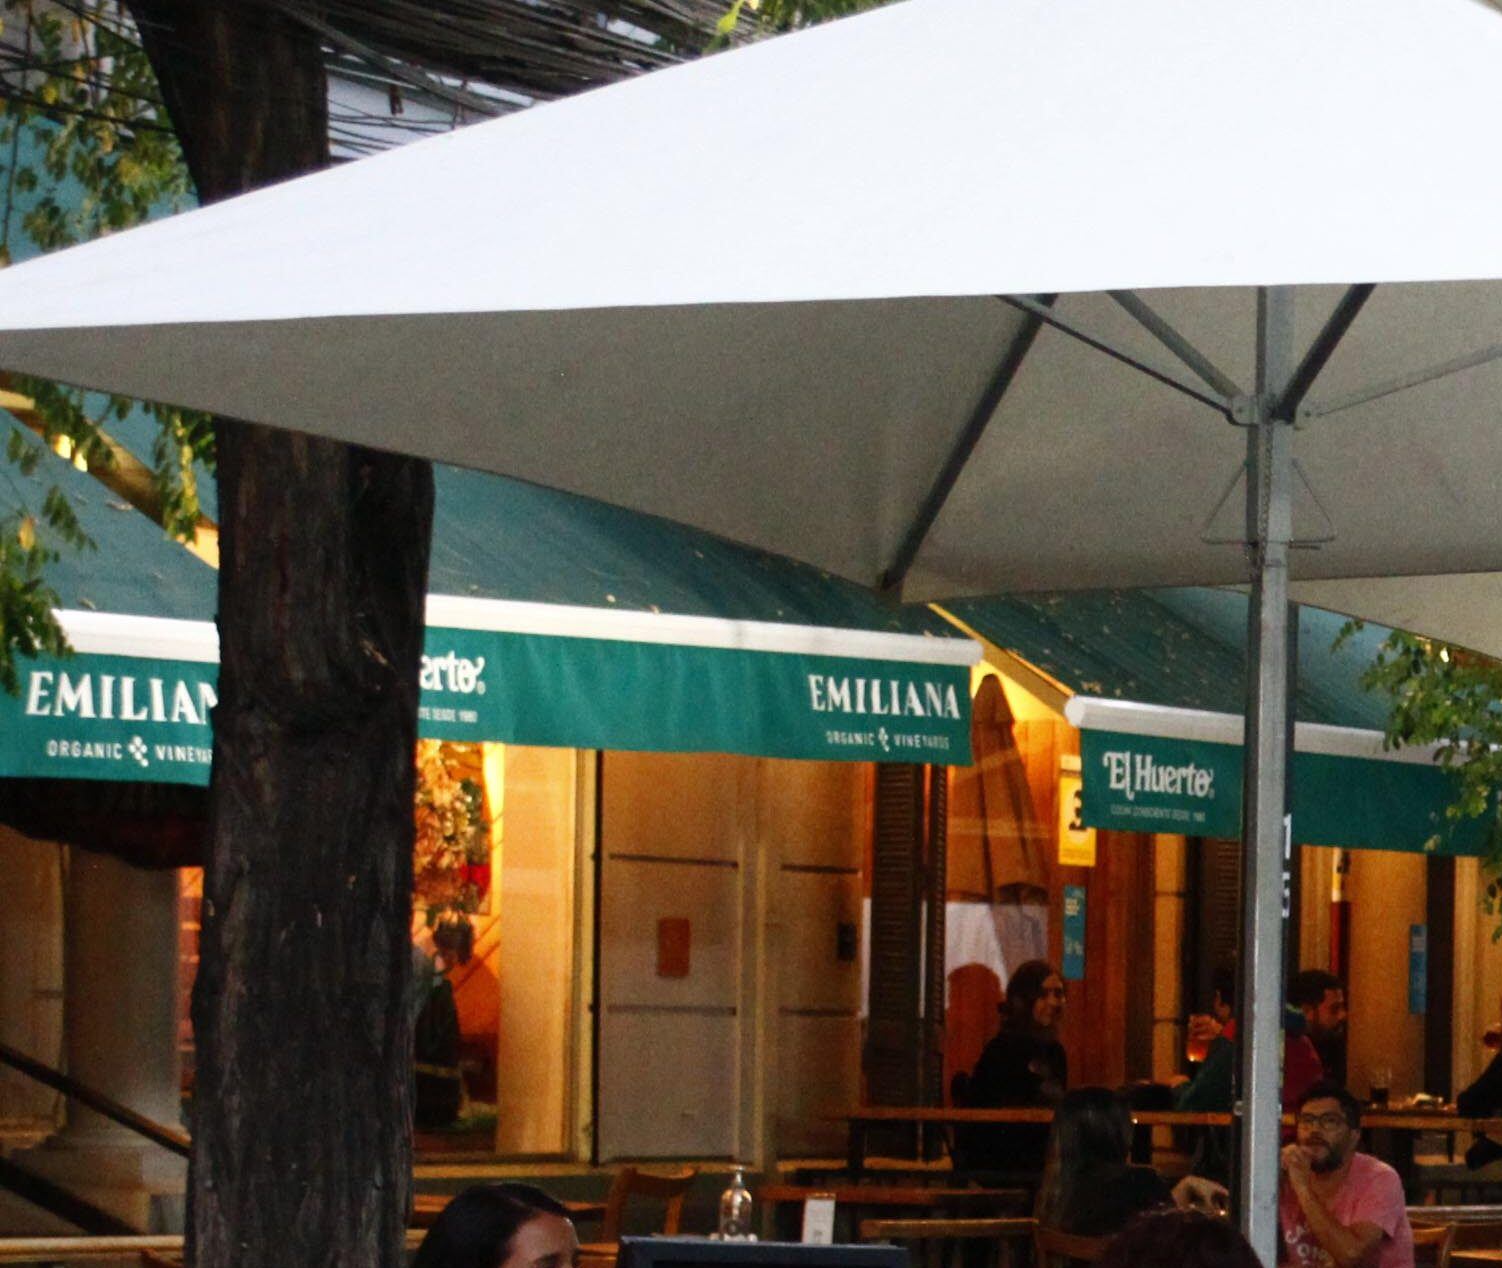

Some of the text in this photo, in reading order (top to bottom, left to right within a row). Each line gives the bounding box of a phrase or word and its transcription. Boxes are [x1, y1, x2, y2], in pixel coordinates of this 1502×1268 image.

[419, 651, 485, 693] erto
[25, 670, 218, 725] EMILIAN
[808, 674, 960, 719] EMILIANA
[46, 738, 123, 760] ORGANIC
[826, 730, 950, 750] ORGANIC VINEYARDS
[1103, 751, 1213, 800] El Huerto
